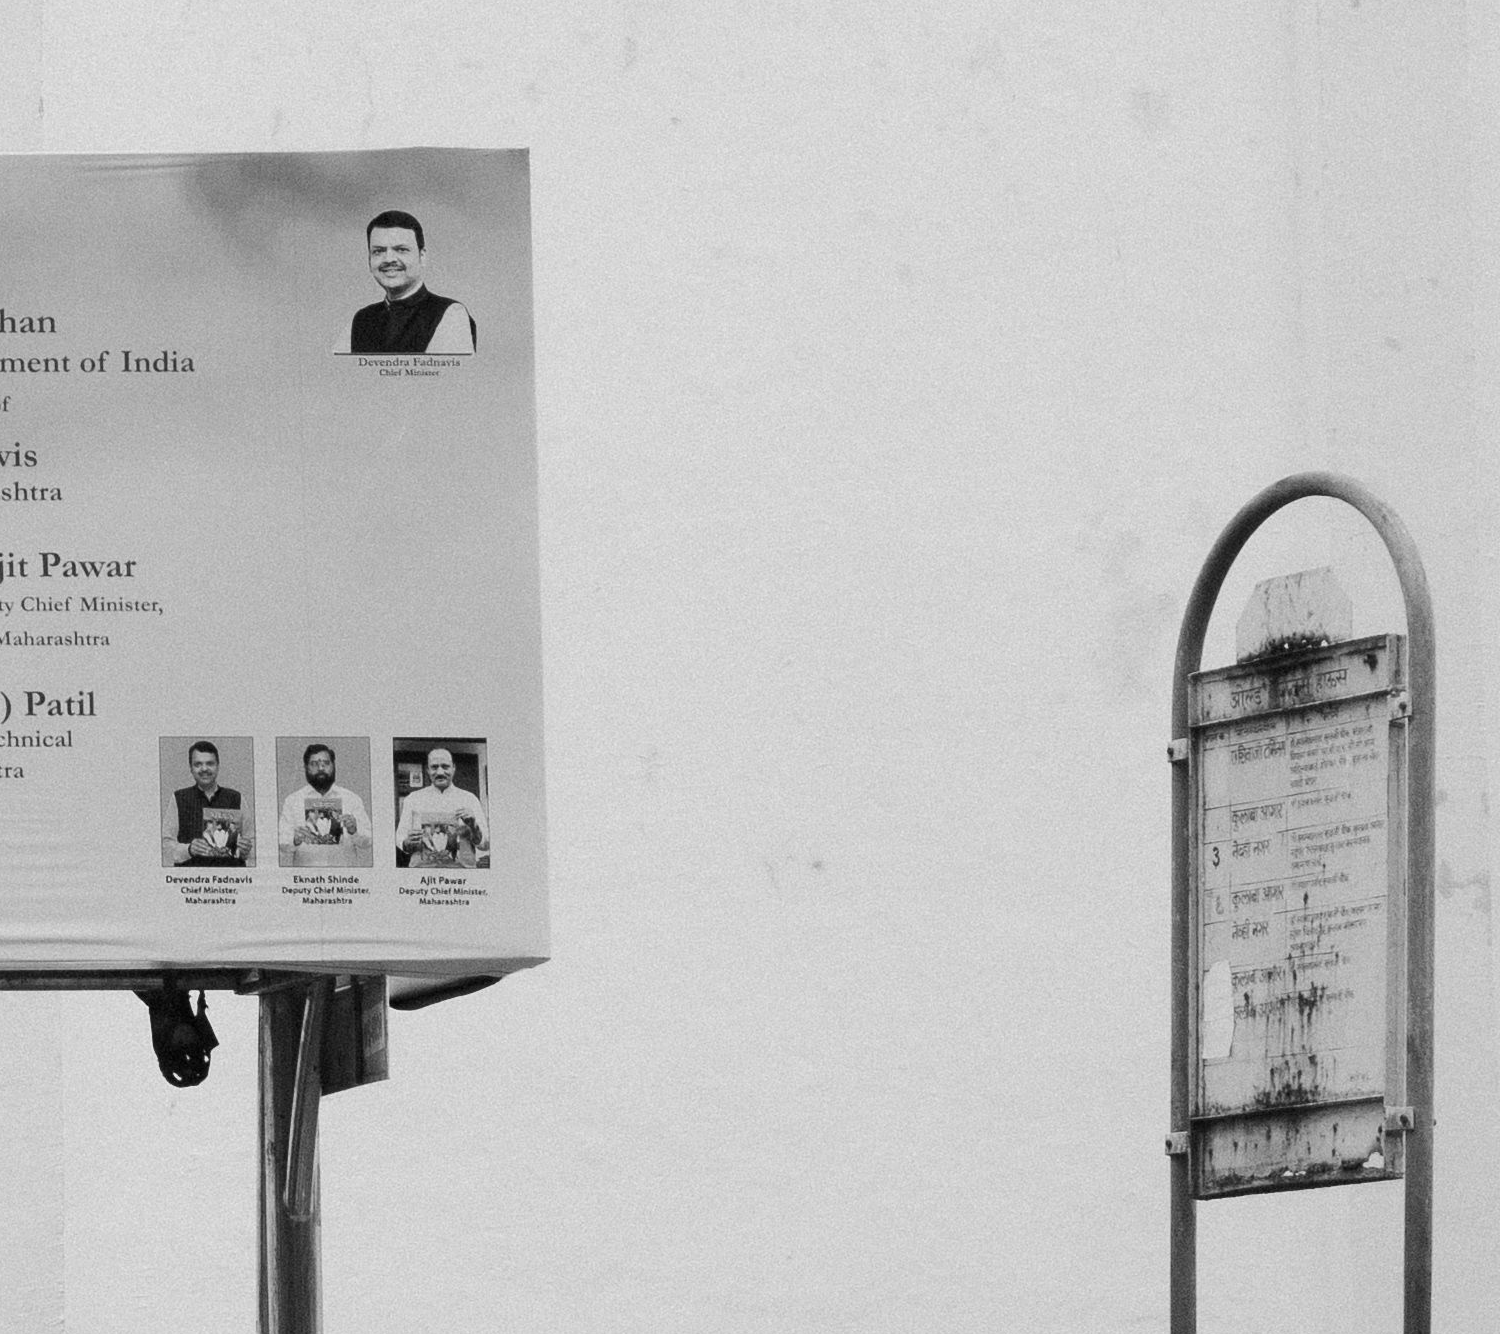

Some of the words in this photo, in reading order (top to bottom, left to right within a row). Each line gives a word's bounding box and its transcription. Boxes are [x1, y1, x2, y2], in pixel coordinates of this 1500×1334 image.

[79, 350, 110, 373] of
[122, 350, 195, 373] India
[358, 357, 410, 367] Devendra
[413, 357, 461, 367] Fadnavis
[378, 368, 402, 377] Chief
[404, 368, 440, 377] Minister
[40, 552, 137, 578] Pawar
[19, 596, 73, 613] Chief
[80, 596, 164, 615] Minister,
[25, 690, 96, 717] Patil
[165, 875, 211, 884] Devendra
[212, 875, 253, 884] Fadnavis
[293, 875, 326, 884] Eknath
[327, 875, 360, 884] Shinde
[420, 876, 437, 887] Ajit
[438, 876, 467, 885] Pawar
[180, 886, 202, 894] Chief
[281, 886, 312, 896] Deputy
[313, 886, 335, 895] Chief
[398, 886, 429, 897] Deputy
[430, 887, 452, 895] Chief
[185, 896, 236, 905] Maharashtra
[302, 897, 353, 905] Maharashtra
[418, 897, 470, 906] Maharashtra
